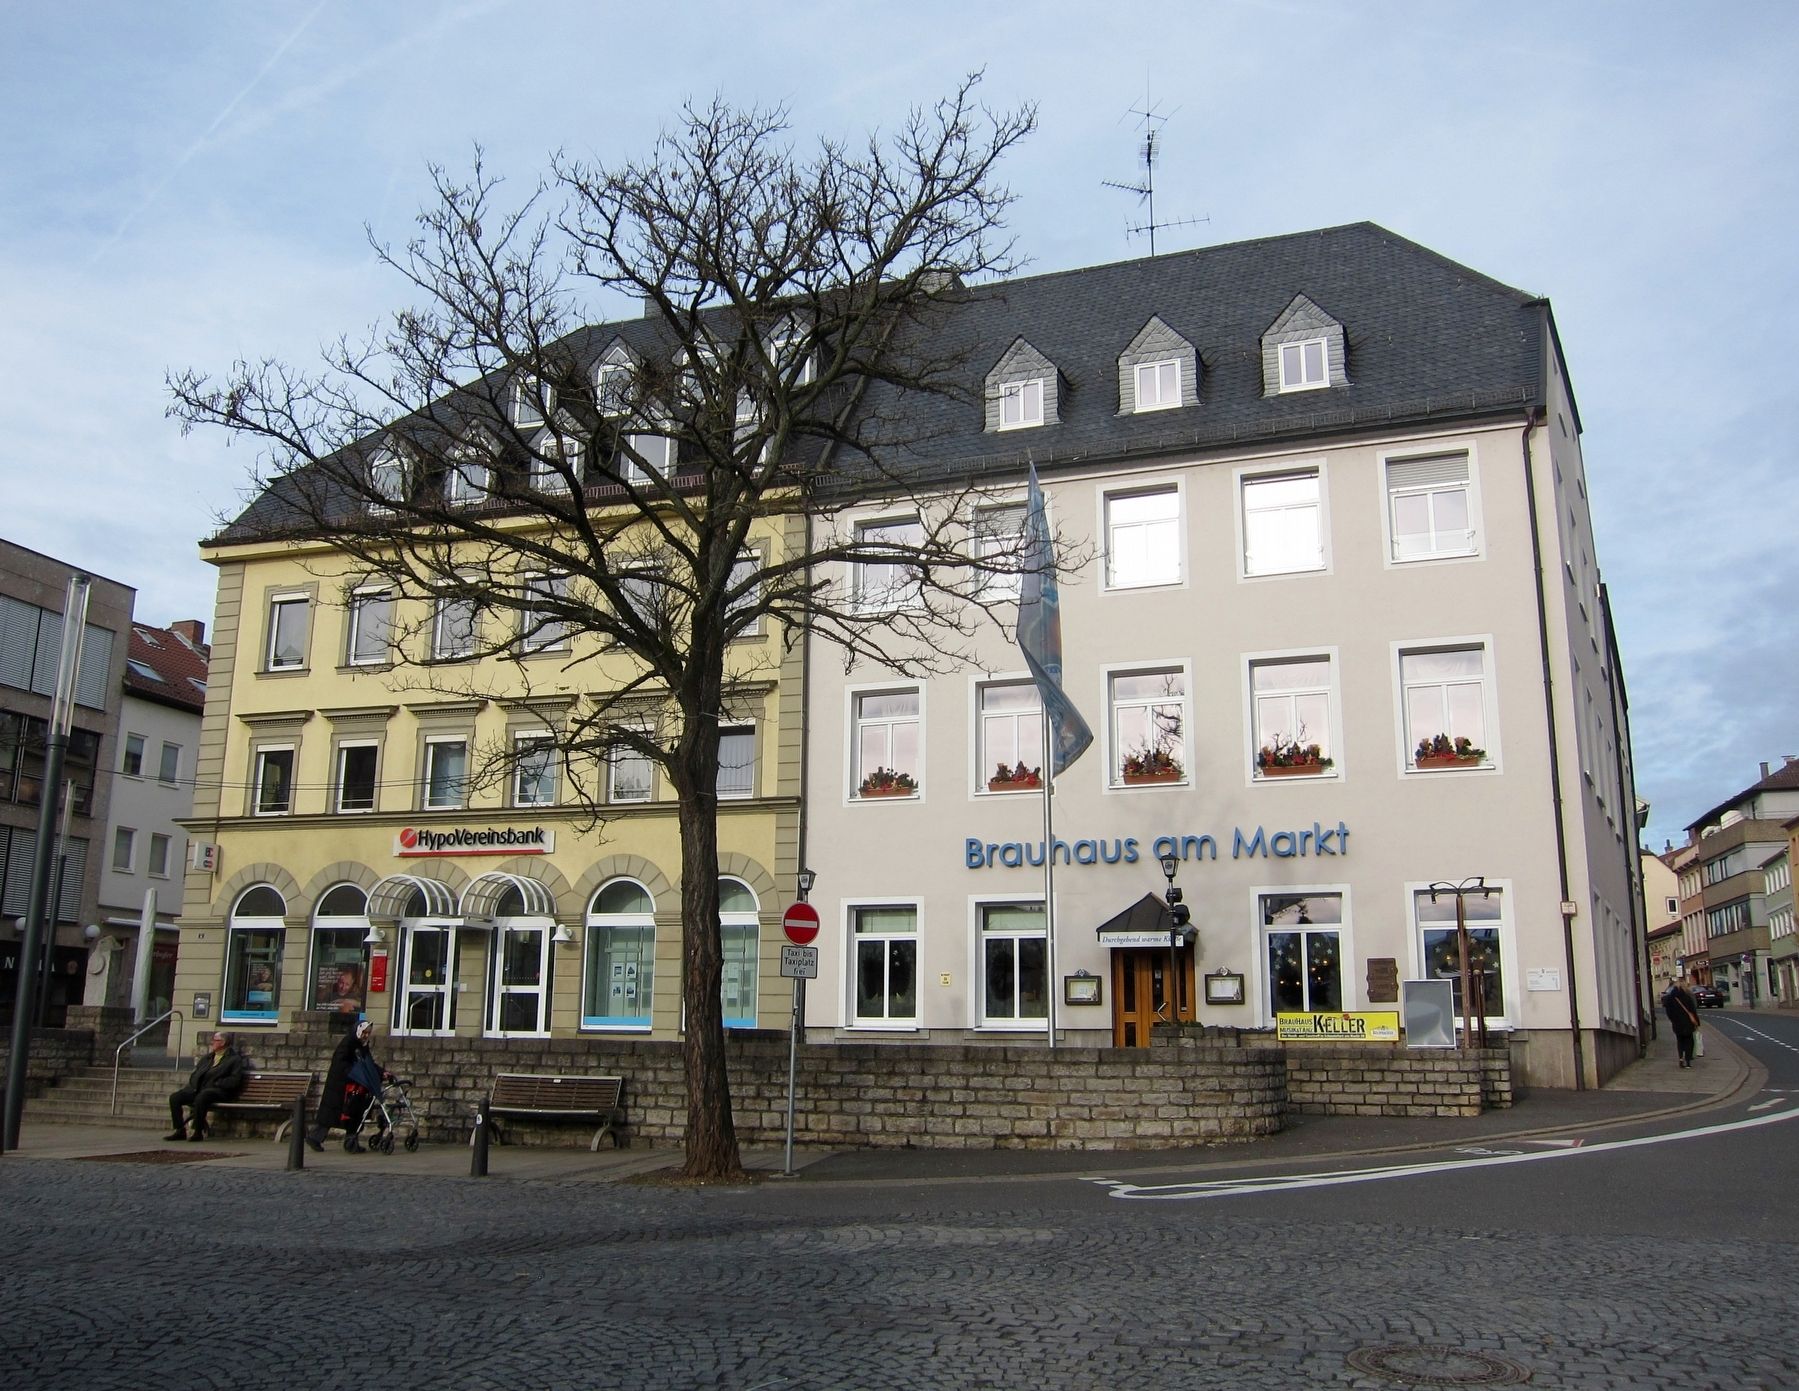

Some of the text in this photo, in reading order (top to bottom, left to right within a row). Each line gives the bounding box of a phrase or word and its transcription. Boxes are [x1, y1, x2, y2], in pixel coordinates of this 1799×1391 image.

[418, 826, 544, 850] HypoVereinsbank
[966, 821, 1350, 868] Brauhaus am Markt
[803, 949, 813, 957] bis
[784, 957, 815, 967] Taxiplatz
